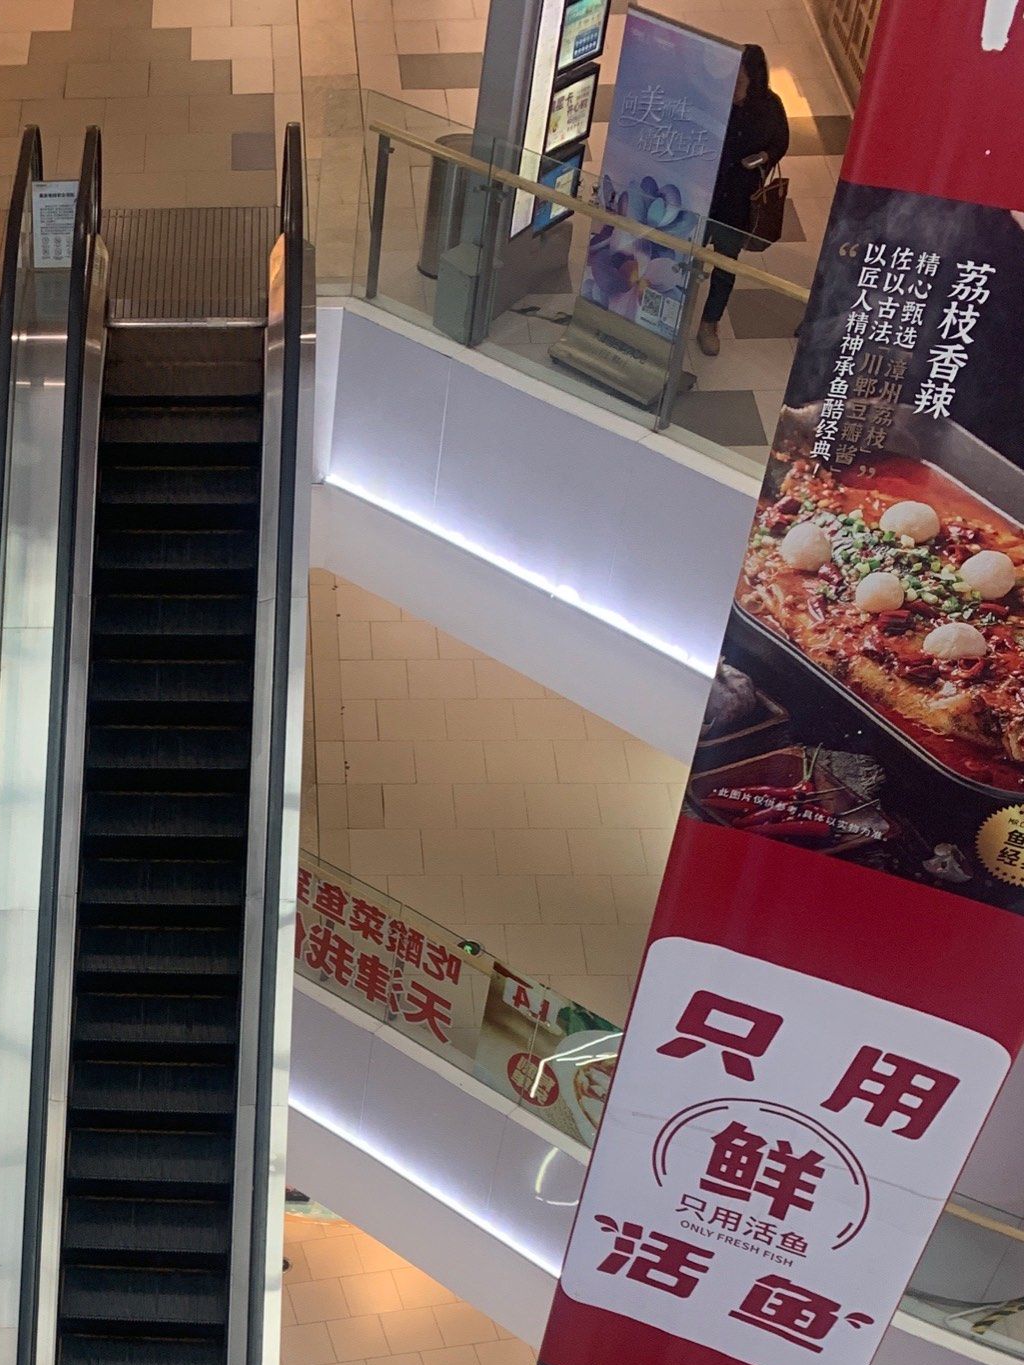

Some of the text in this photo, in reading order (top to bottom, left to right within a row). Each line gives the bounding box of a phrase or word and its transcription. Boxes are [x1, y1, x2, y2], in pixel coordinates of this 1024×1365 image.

[913, 260, 996, 419] 荔枝香辣
[656, 989, 960, 1140] 只用
[700, 1121, 825, 1221] 鲜
[675, 1193, 808, 1258] 只用活鱼
[680, 1220, 794, 1268] ONLY FRESH FISH
